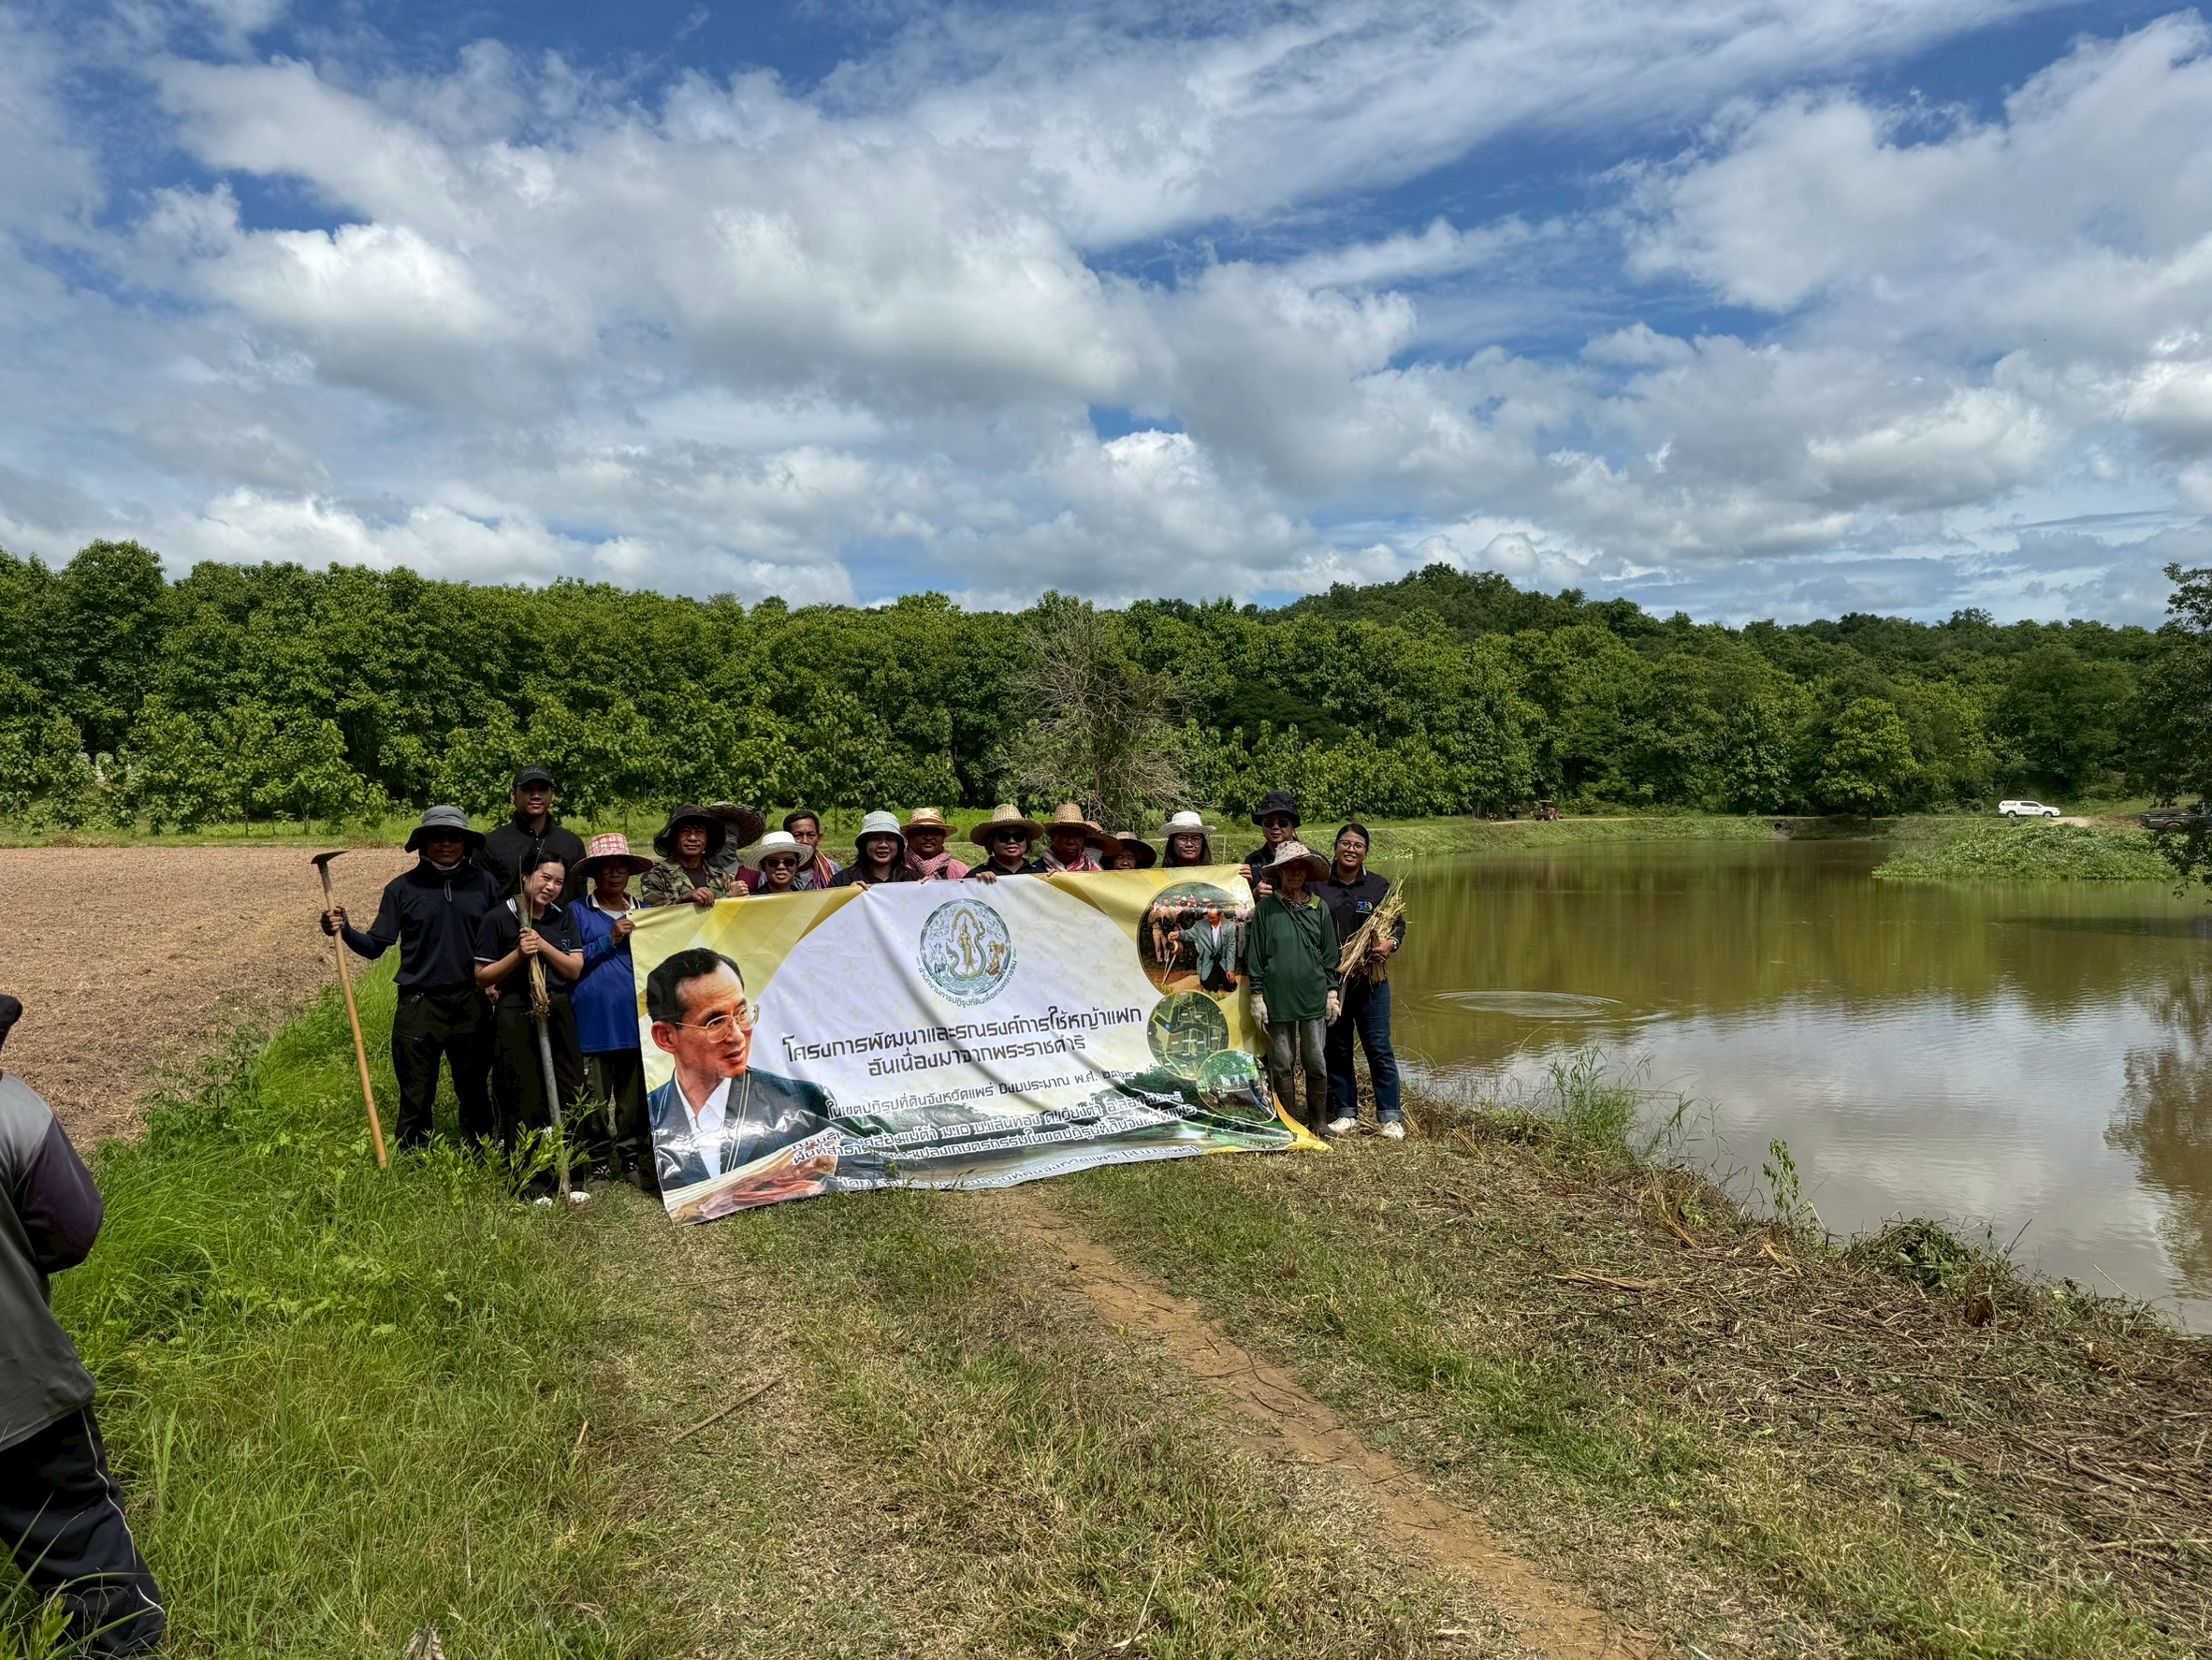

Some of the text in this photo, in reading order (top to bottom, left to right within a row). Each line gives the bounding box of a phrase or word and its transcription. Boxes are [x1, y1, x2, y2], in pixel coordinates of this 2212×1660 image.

[867, 1034, 1086, 1077] อันเนื่องมาจากพระราชดำริ
[826, 1082, 994, 1119] ในเขตปฏิรูปที่ดินจังหวัดแพร่
[998, 1078, 1070, 1096] ปีงบประมาณ
[1074, 1070, 1099, 1085] พ.ศ.
